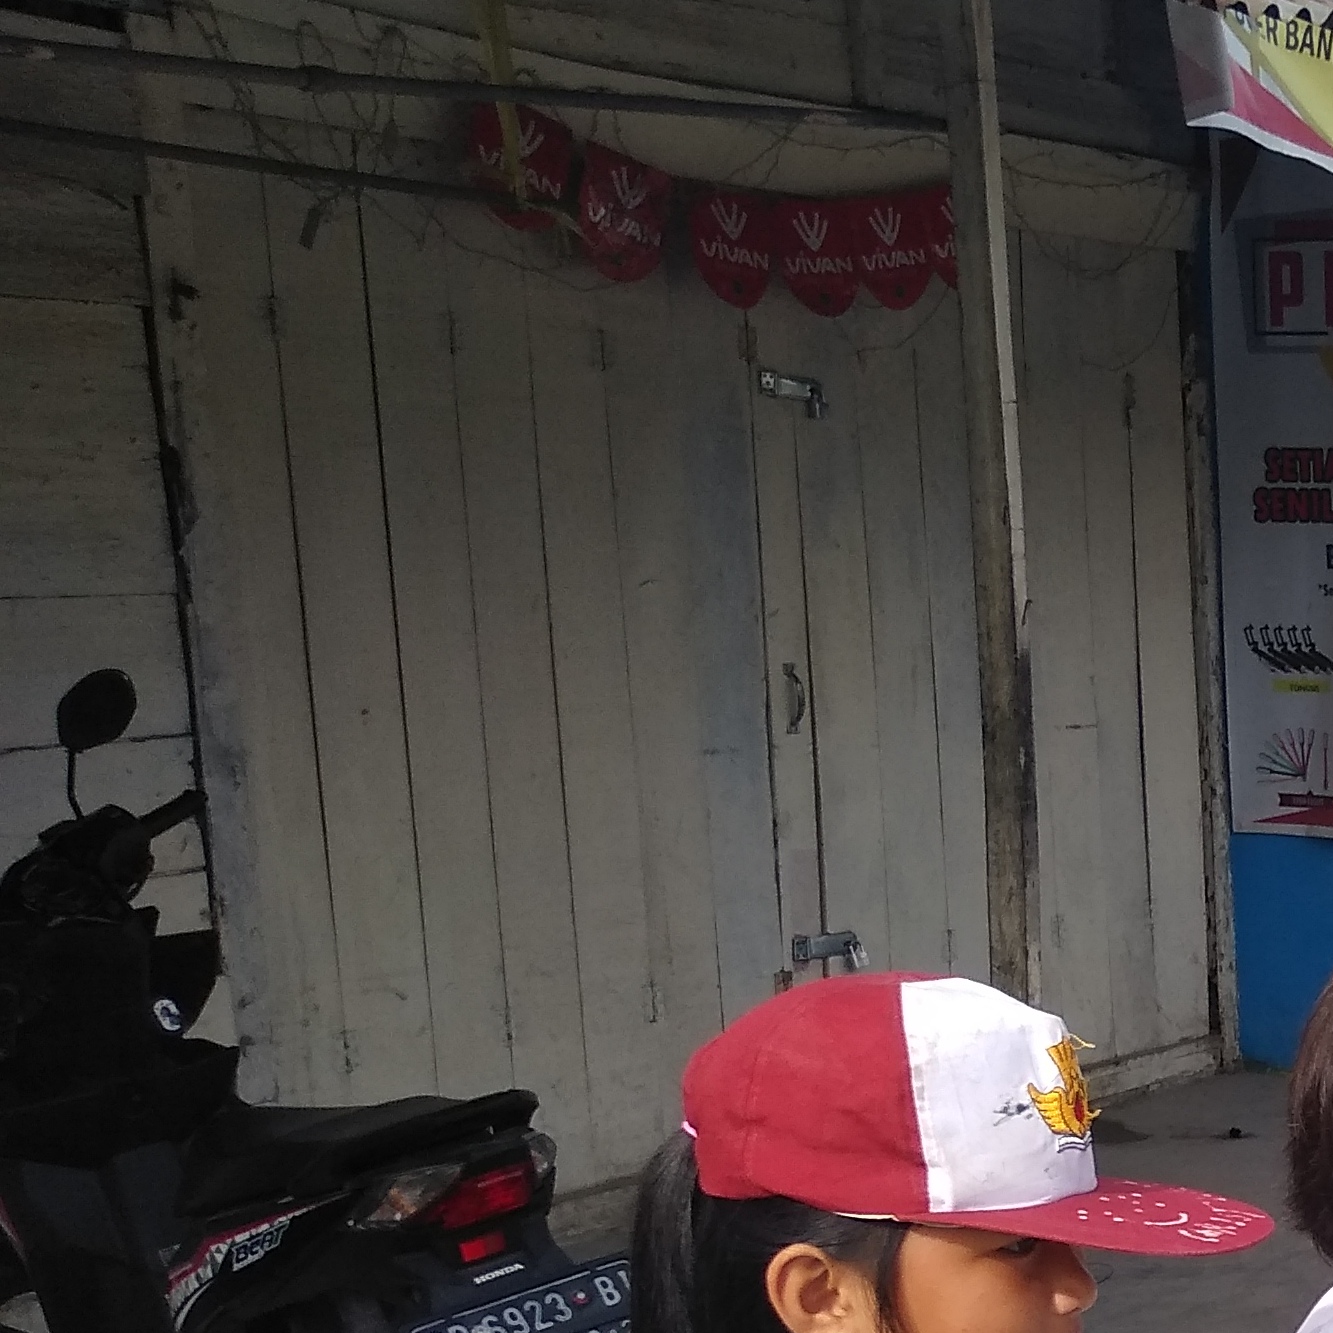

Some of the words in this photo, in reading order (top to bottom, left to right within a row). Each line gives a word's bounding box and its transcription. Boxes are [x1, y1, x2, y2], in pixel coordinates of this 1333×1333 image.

[700, 235, 770, 271] VIVAN
[785, 250, 854, 275] VIVAN
[862, 247, 927, 271] VIVAN
[473, 1263, 526, 1285] HONDA
